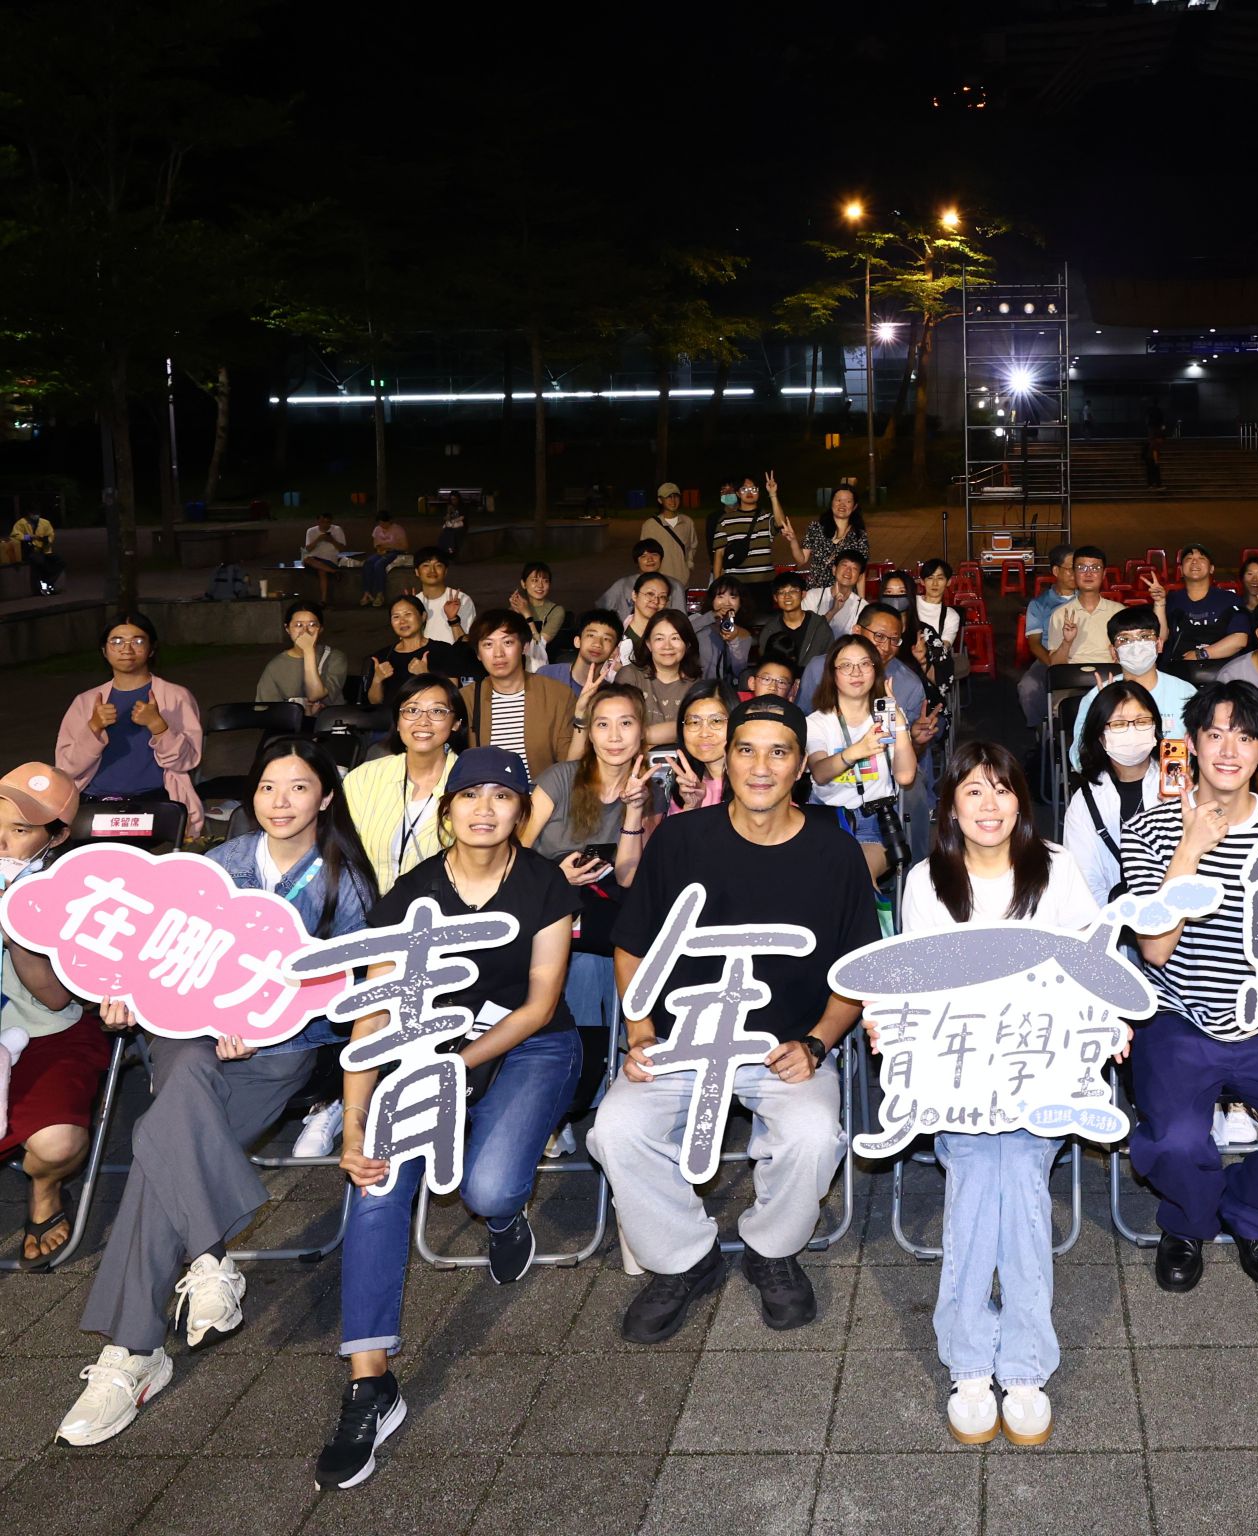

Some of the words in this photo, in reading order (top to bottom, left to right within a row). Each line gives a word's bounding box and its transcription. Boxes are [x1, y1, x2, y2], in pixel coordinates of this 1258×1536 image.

[110, 817, 140, 828] 保留席
[289, 904, 513, 1187] 青
[630, 890, 809, 1176] 年
[870, 1001, 1121, 1099] 青年學堂
